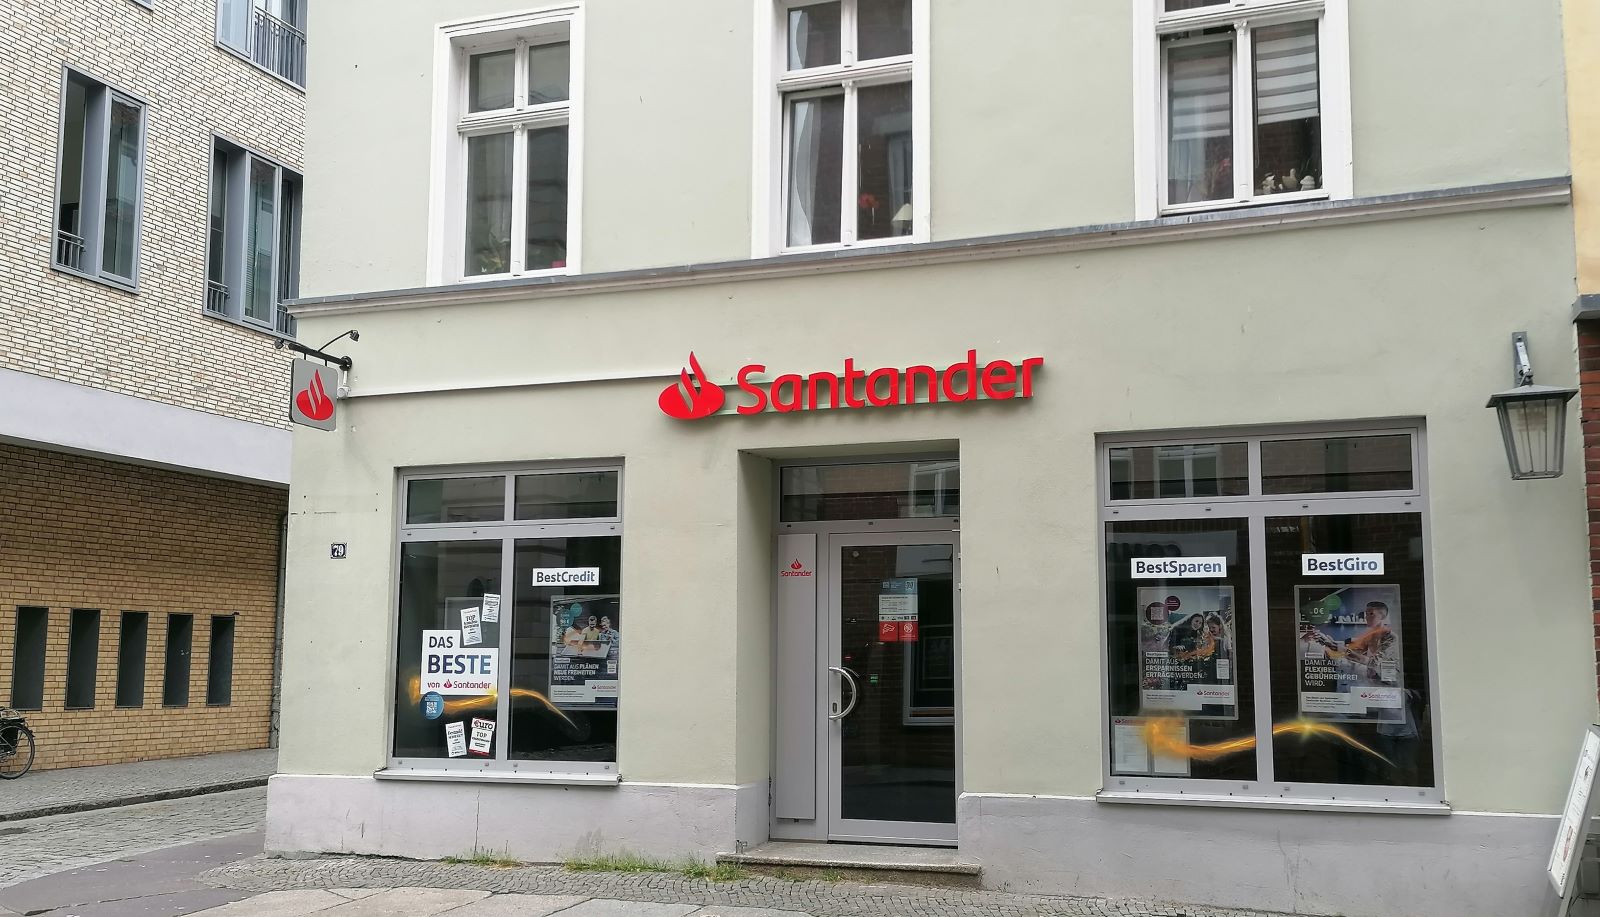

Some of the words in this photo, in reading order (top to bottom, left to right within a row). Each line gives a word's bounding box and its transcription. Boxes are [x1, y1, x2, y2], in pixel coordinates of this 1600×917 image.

[736, 349, 1044, 415] Santander
[332, 544, 344, 557] 79
[1136, 561, 1222, 576] BestSparen
[1307, 557, 1378, 571] BestGiro
[536, 571, 595, 583] BestCredit
[428, 636, 454, 648] DAS
[427, 654, 492, 675] BESTE
[1304, 672, 1358, 681] GEBÜHRENFREI
[453, 680, 491, 689] Santander
